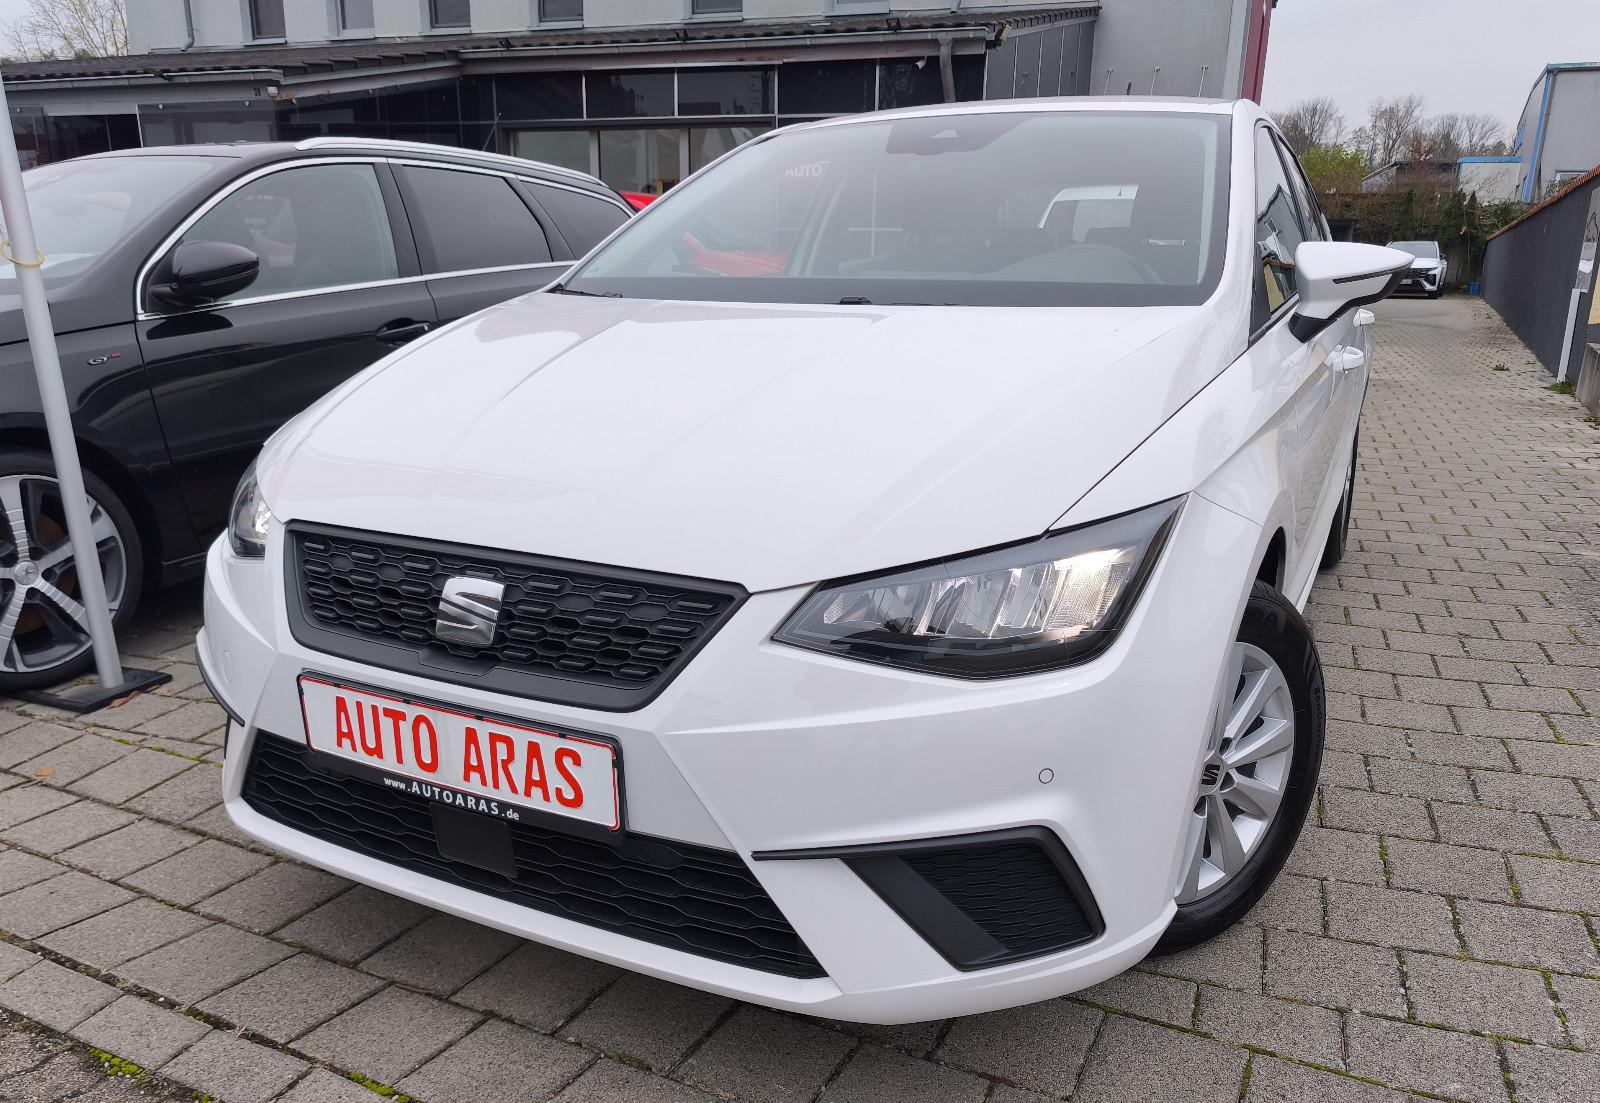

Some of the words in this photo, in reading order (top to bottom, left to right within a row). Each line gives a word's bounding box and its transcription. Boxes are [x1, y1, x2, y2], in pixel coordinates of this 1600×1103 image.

[335, 695, 439, 774] AUTO
[463, 726, 584, 809] ARAS
[383, 777, 520, 821] www.AUTOARAS.de
